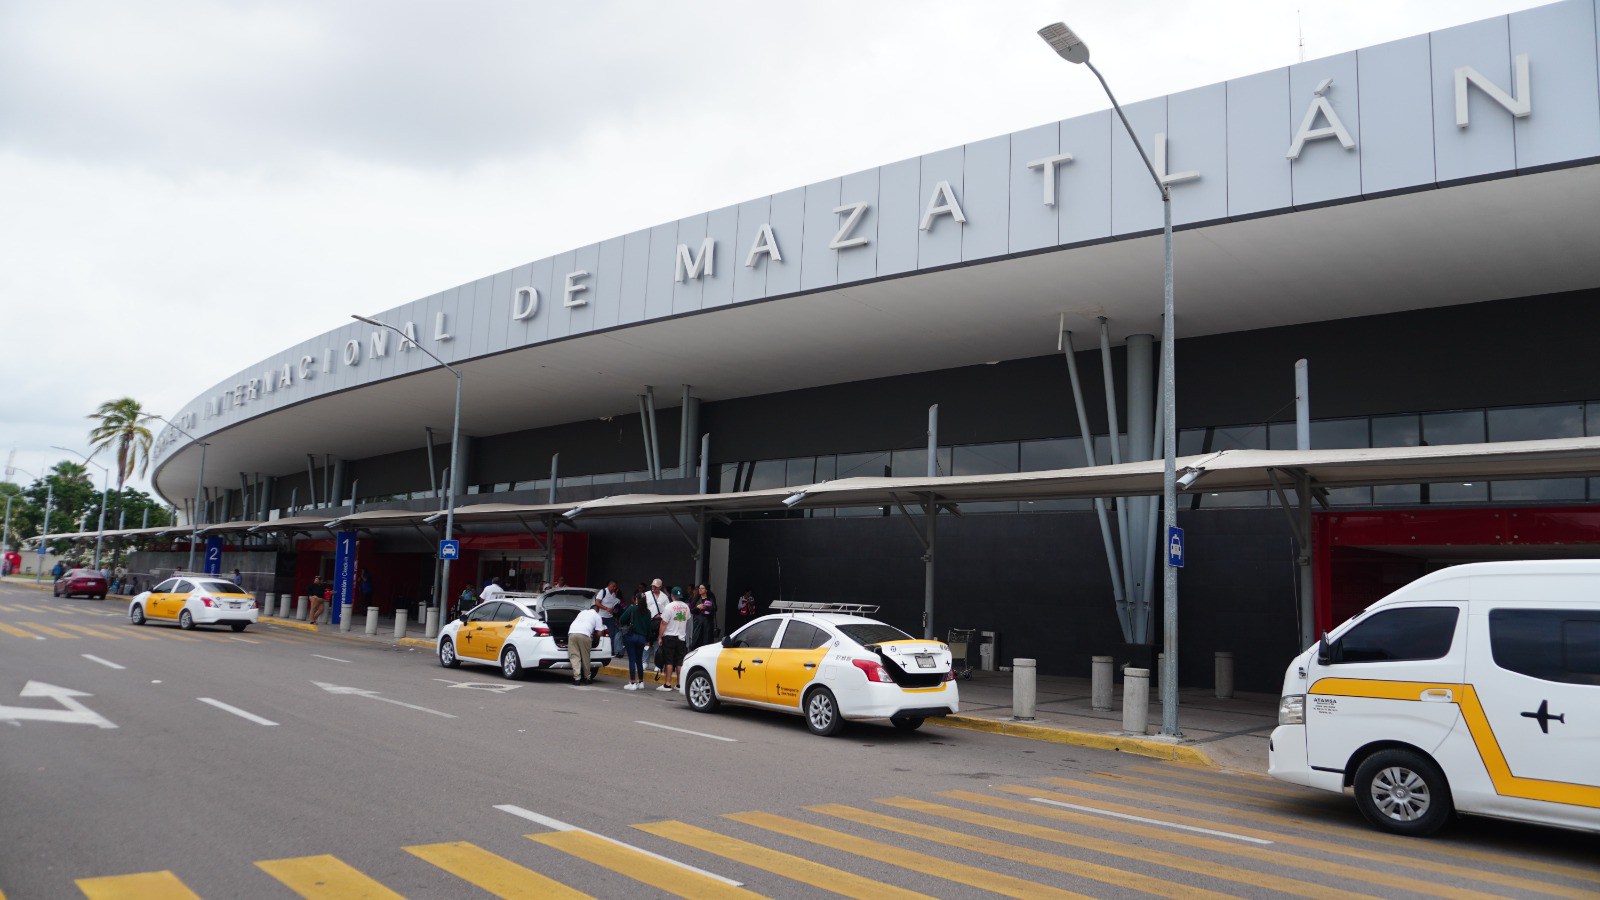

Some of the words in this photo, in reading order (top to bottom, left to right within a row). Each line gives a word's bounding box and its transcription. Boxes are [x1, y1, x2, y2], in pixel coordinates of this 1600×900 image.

[203, 311, 452, 421] INTERNACIONAL
[512, 269, 590, 321] DE
[675, 53, 1532, 283] MAZATLÁN
[209, 547, 218, 560] 2
[343, 539, 349, 554] 1
